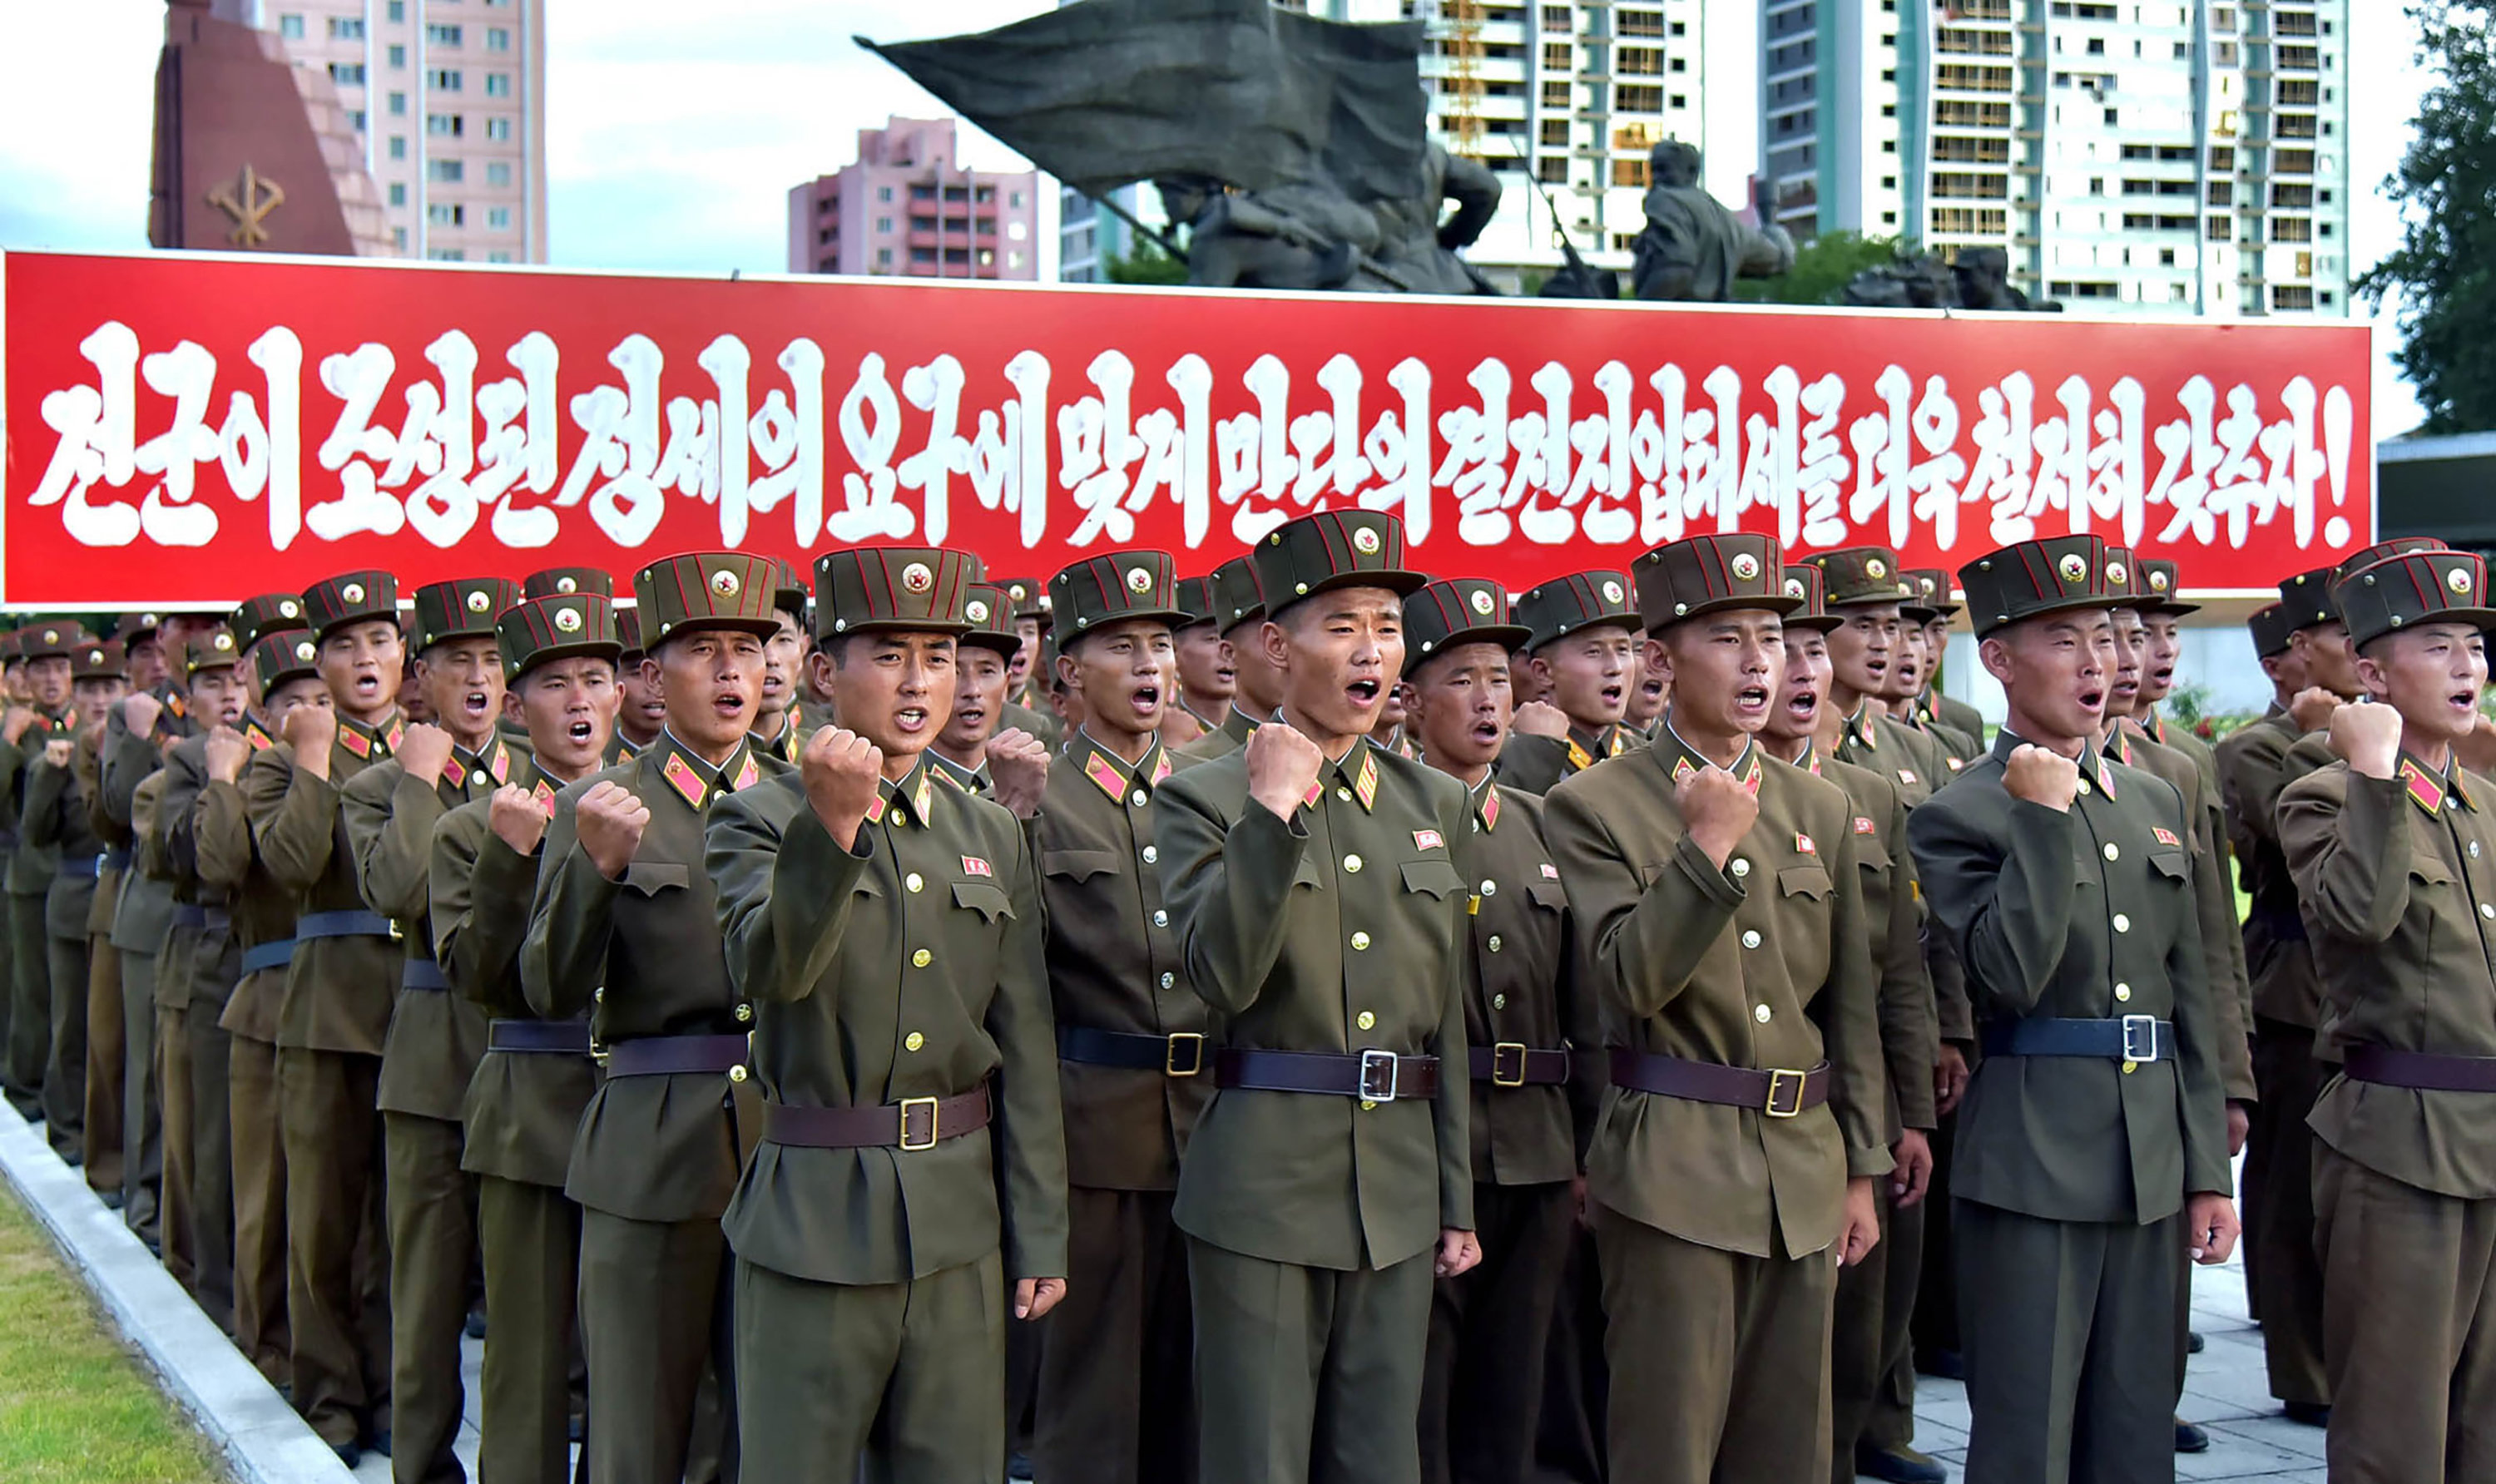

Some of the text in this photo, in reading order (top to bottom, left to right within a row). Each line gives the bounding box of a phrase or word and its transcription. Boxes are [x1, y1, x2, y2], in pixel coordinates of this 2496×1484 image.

[28, 321, 302, 551] 전군이
[306, 329, 559, 548] 조성된
[552, 334, 825, 549] 정세의
[827, 350, 1052, 548] 요구에
[1057, 349, 1213, 549] 맞게
[1849, 364, 1967, 552] 더욱
[1959, 369, 2146, 549] 철저히
[2146, 373, 2354, 551] 갖추자!
